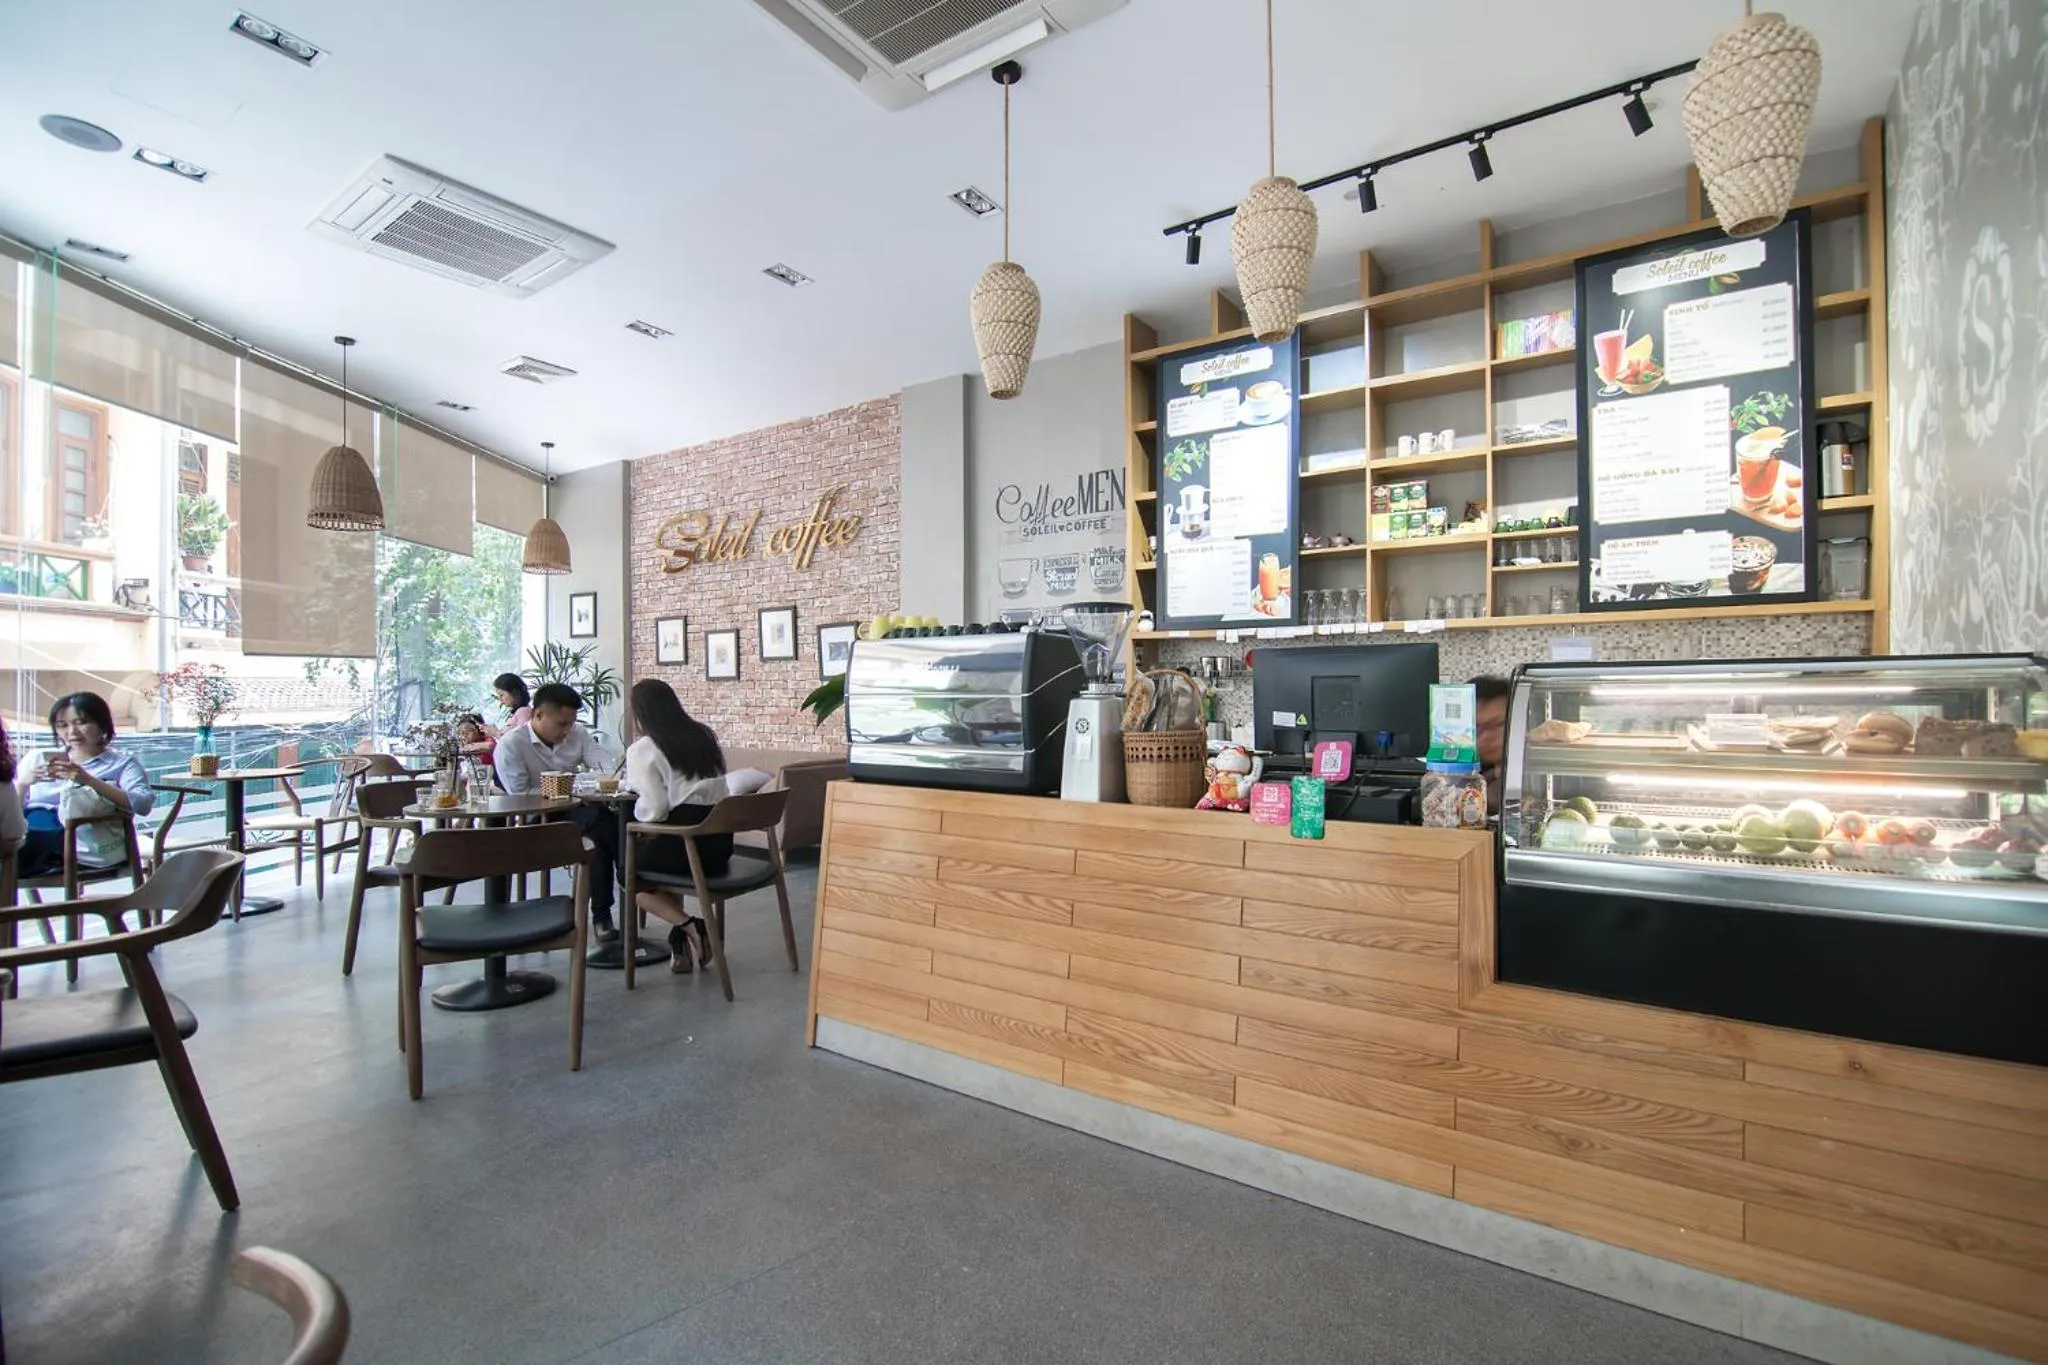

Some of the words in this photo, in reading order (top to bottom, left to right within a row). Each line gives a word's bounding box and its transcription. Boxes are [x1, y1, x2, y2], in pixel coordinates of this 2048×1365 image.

[1647, 255, 1687, 278] Soleil
[1688, 251, 1727, 272] coffee
[996, 483, 1076, 524] Coffee
[655, 509, 763, 574] Soleil
[766, 482, 865, 569] coffee
[1022, 526, 1060, 537] SOLEIL
[1066, 518, 1108, 532] COFFEE
